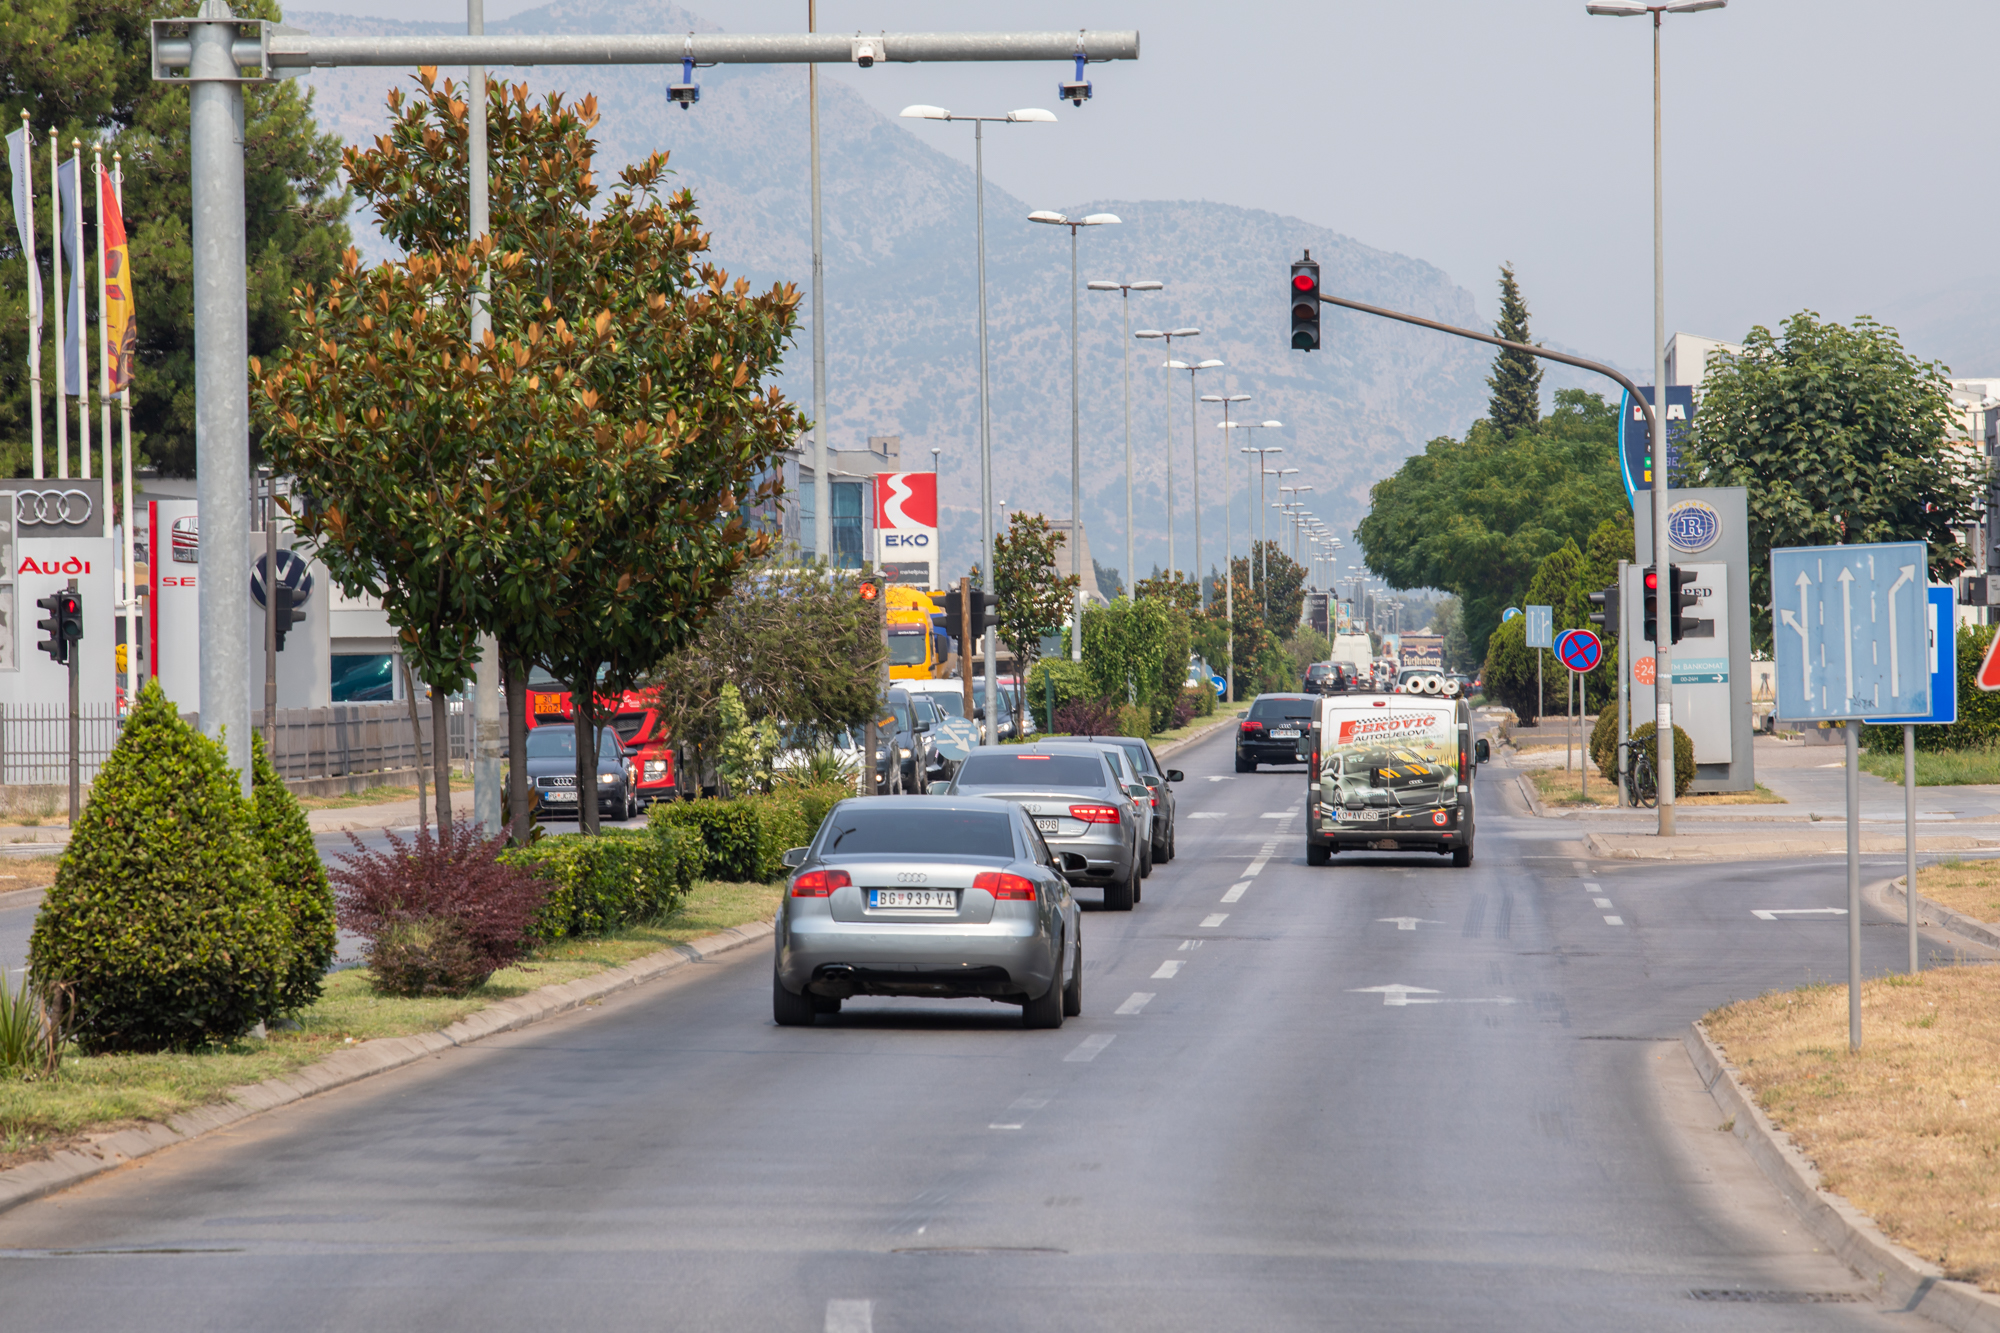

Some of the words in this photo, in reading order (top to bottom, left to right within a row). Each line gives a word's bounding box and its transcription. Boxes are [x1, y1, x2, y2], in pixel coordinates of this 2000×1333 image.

[885, 534, 929, 546] EKO
[17, 556, 91, 575] Audi
[162, 576, 196, 587] SE
[1640, 665, 1655, 676] 24
[1683, 662, 1724, 671] BANKOMAT
[543, 695, 553, 703] 30
[538, 704, 559, 713] 1202
[1354, 729, 1426, 742] AUTODJELOVI
[1040, 820, 1057, 829] 898
[880, 892, 896, 905] BG
